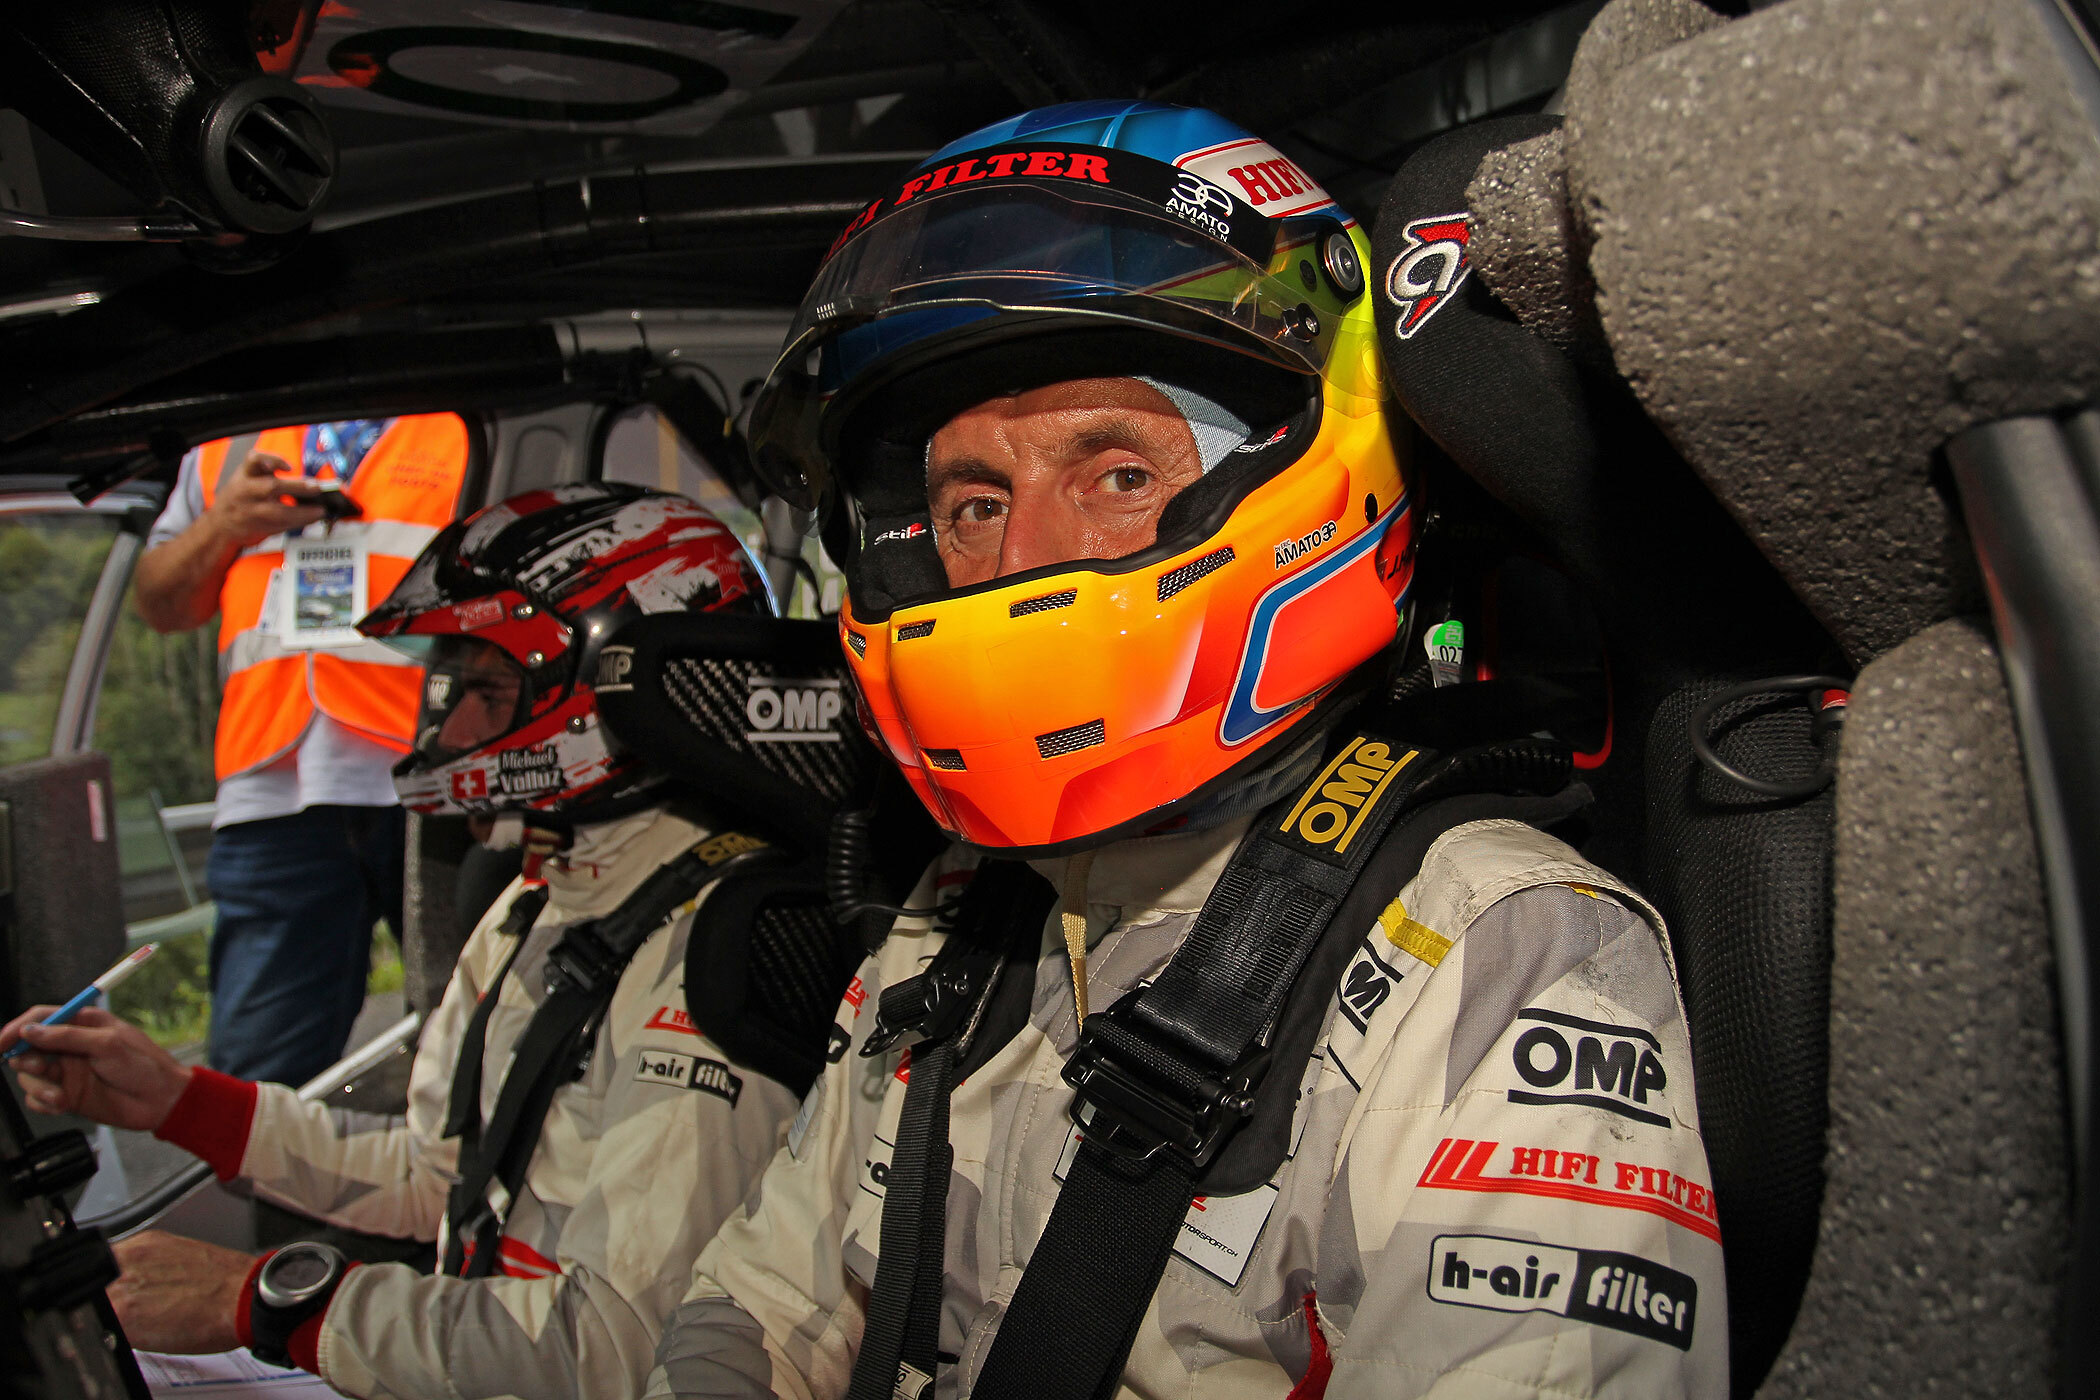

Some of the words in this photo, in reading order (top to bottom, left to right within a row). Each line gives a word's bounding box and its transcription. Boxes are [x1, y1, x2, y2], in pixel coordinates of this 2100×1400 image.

[894, 151, 1111, 206] FILTER
[1165, 206, 1229, 243] DESIGN
[1166, 197, 1231, 236] AMATO
[1275, 530, 1322, 569] AMATO
[746, 687, 842, 732] OMP
[502, 745, 556, 770] Michael
[1298, 741, 1395, 845] OMP
[1512, 1026, 1667, 1105] OMP
[1508, 1146, 1600, 1184] HIFI
[1181, 1221, 1239, 1257] OTORSPORT.CH
[1442, 1250, 1560, 1299] h-air
[1586, 1265, 1687, 1332] filter
